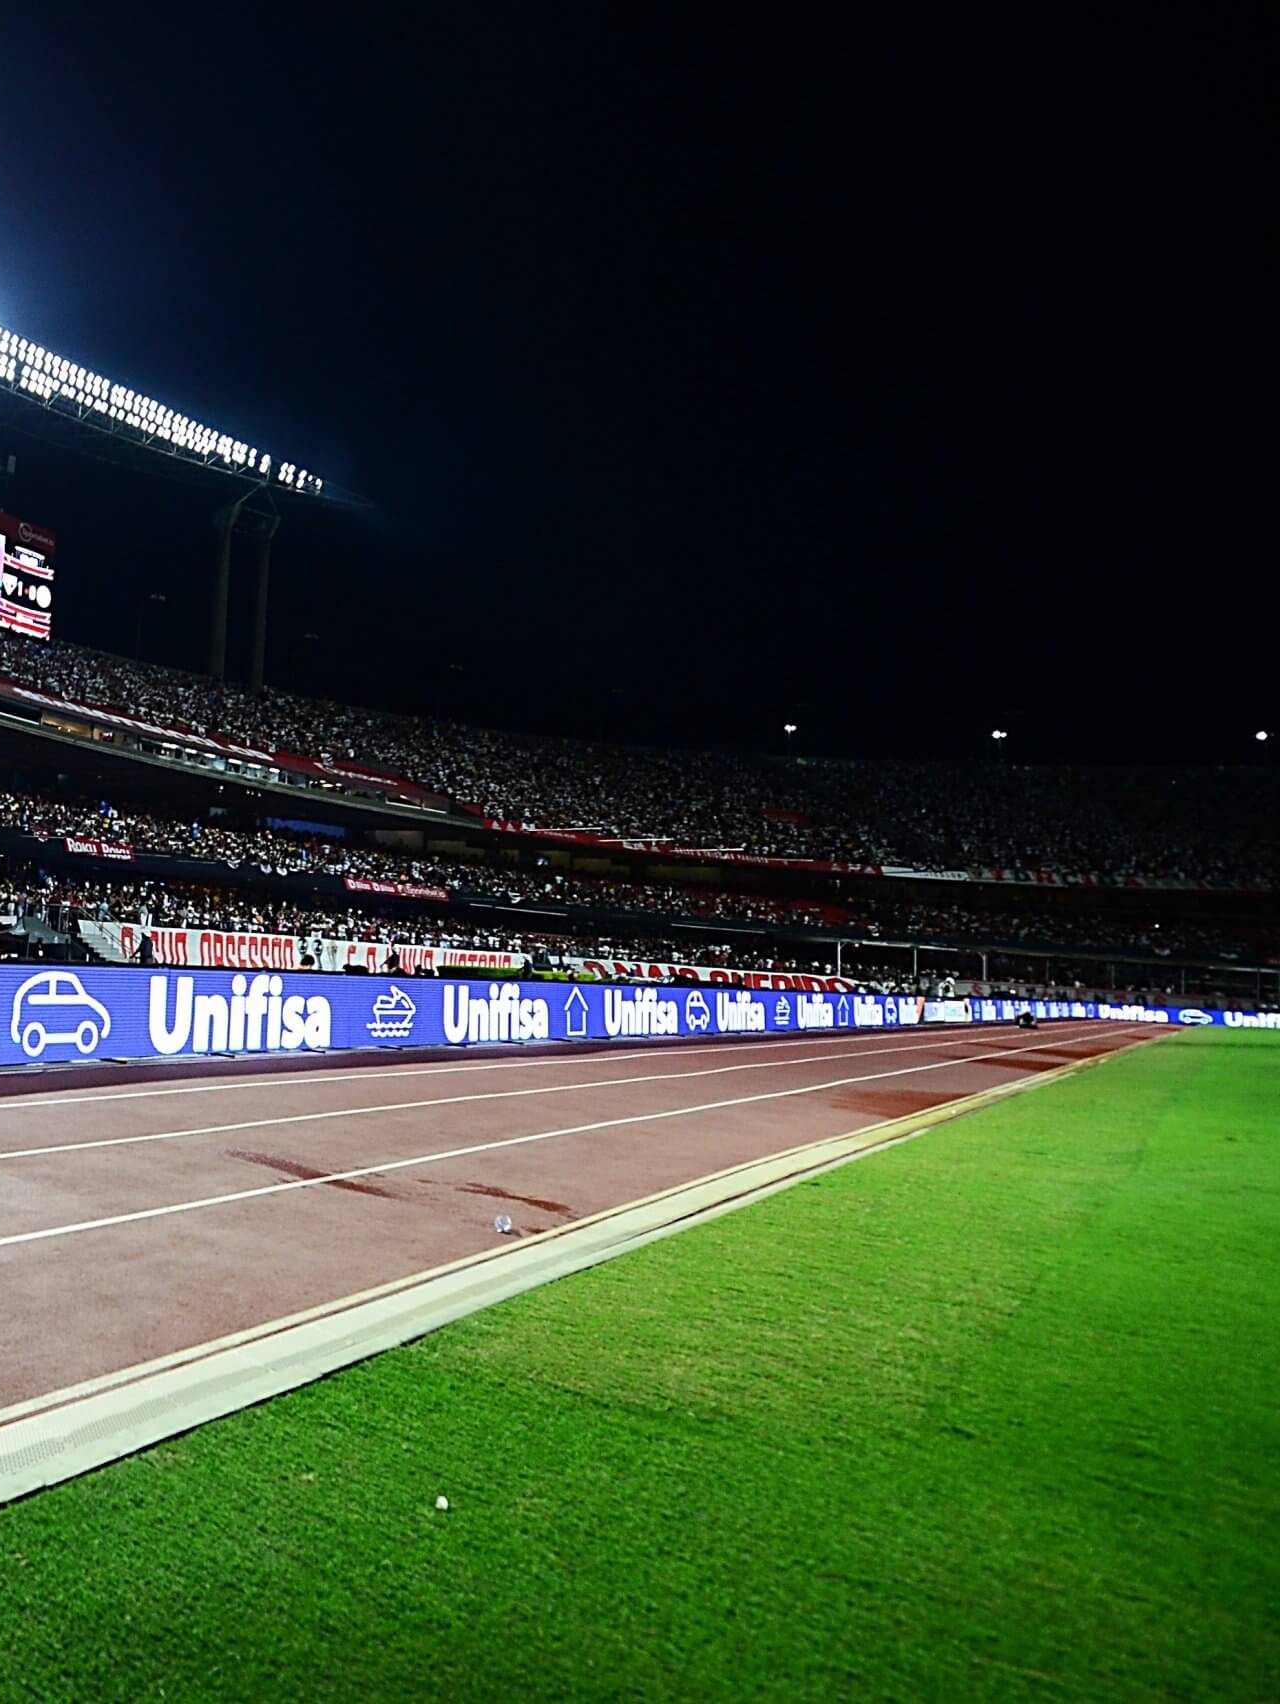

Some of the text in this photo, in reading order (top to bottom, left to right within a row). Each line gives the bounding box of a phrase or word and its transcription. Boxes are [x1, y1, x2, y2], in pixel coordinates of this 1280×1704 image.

[149, 974, 331, 1055] Unifisa
[443, 983, 549, 1044] Unifisa
[604, 987, 678, 1036] Unifisa
[716, 991, 765, 1032] Unifisa
[1098, 1004, 1169, 1023] Unifisa
